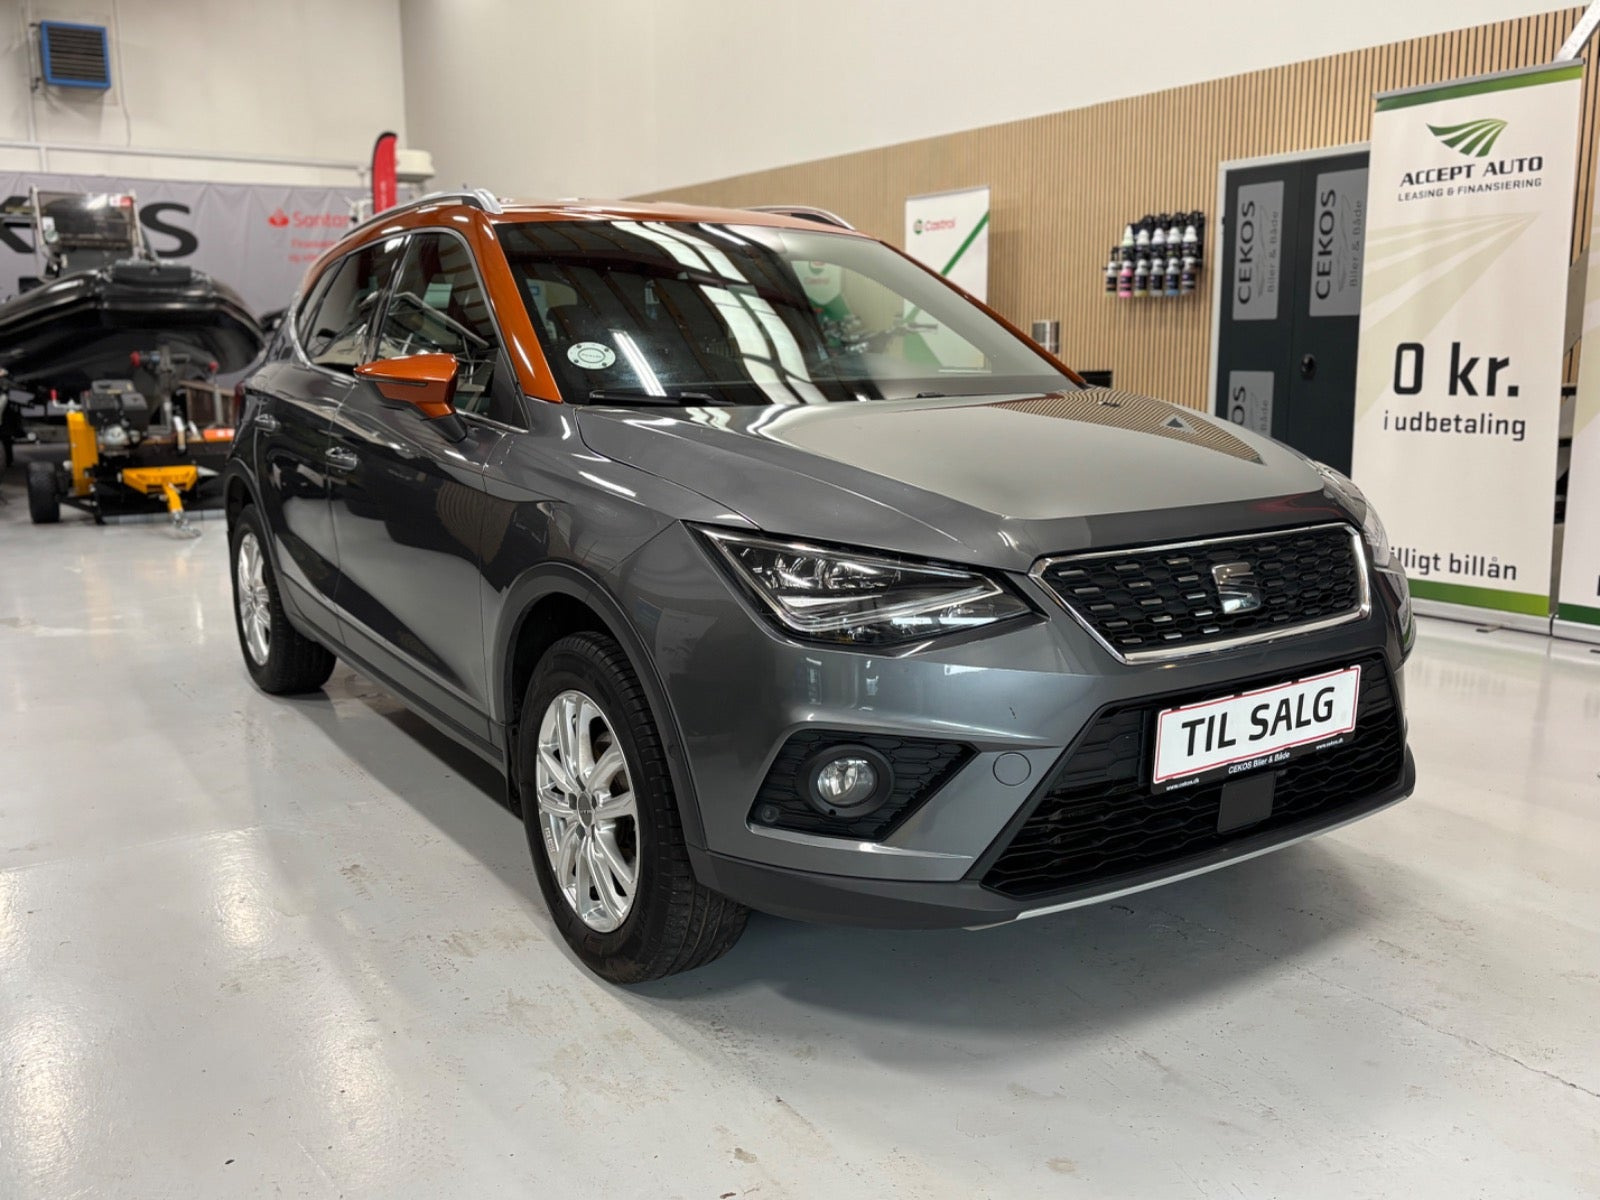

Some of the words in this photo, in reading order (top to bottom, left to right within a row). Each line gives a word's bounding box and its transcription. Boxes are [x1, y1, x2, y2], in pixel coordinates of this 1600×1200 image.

[1400, 164, 1476, 187] ACCEPT
[1483, 156, 1543, 177] AUTO
[1398, 187, 1444, 202] LEASING
[1447, 187, 1454, 196] &
[1458, 178, 1542, 195] FINANSIERING
[1238, 201, 1255, 304] CEKOS
[1315, 189, 1336, 300] CEKOS
[1394, 342, 1424, 395] 0
[1448, 341, 1519, 397] kr.
[1384, 410, 1388, 430] i
[1395, 411, 1526, 441] udbetaling
[1449, 553, 1517, 580] billån
[1181, 711, 1236, 756] TIL
[1248, 686, 1335, 741] SALG
[1228, 760, 1252, 775] CEKOS
